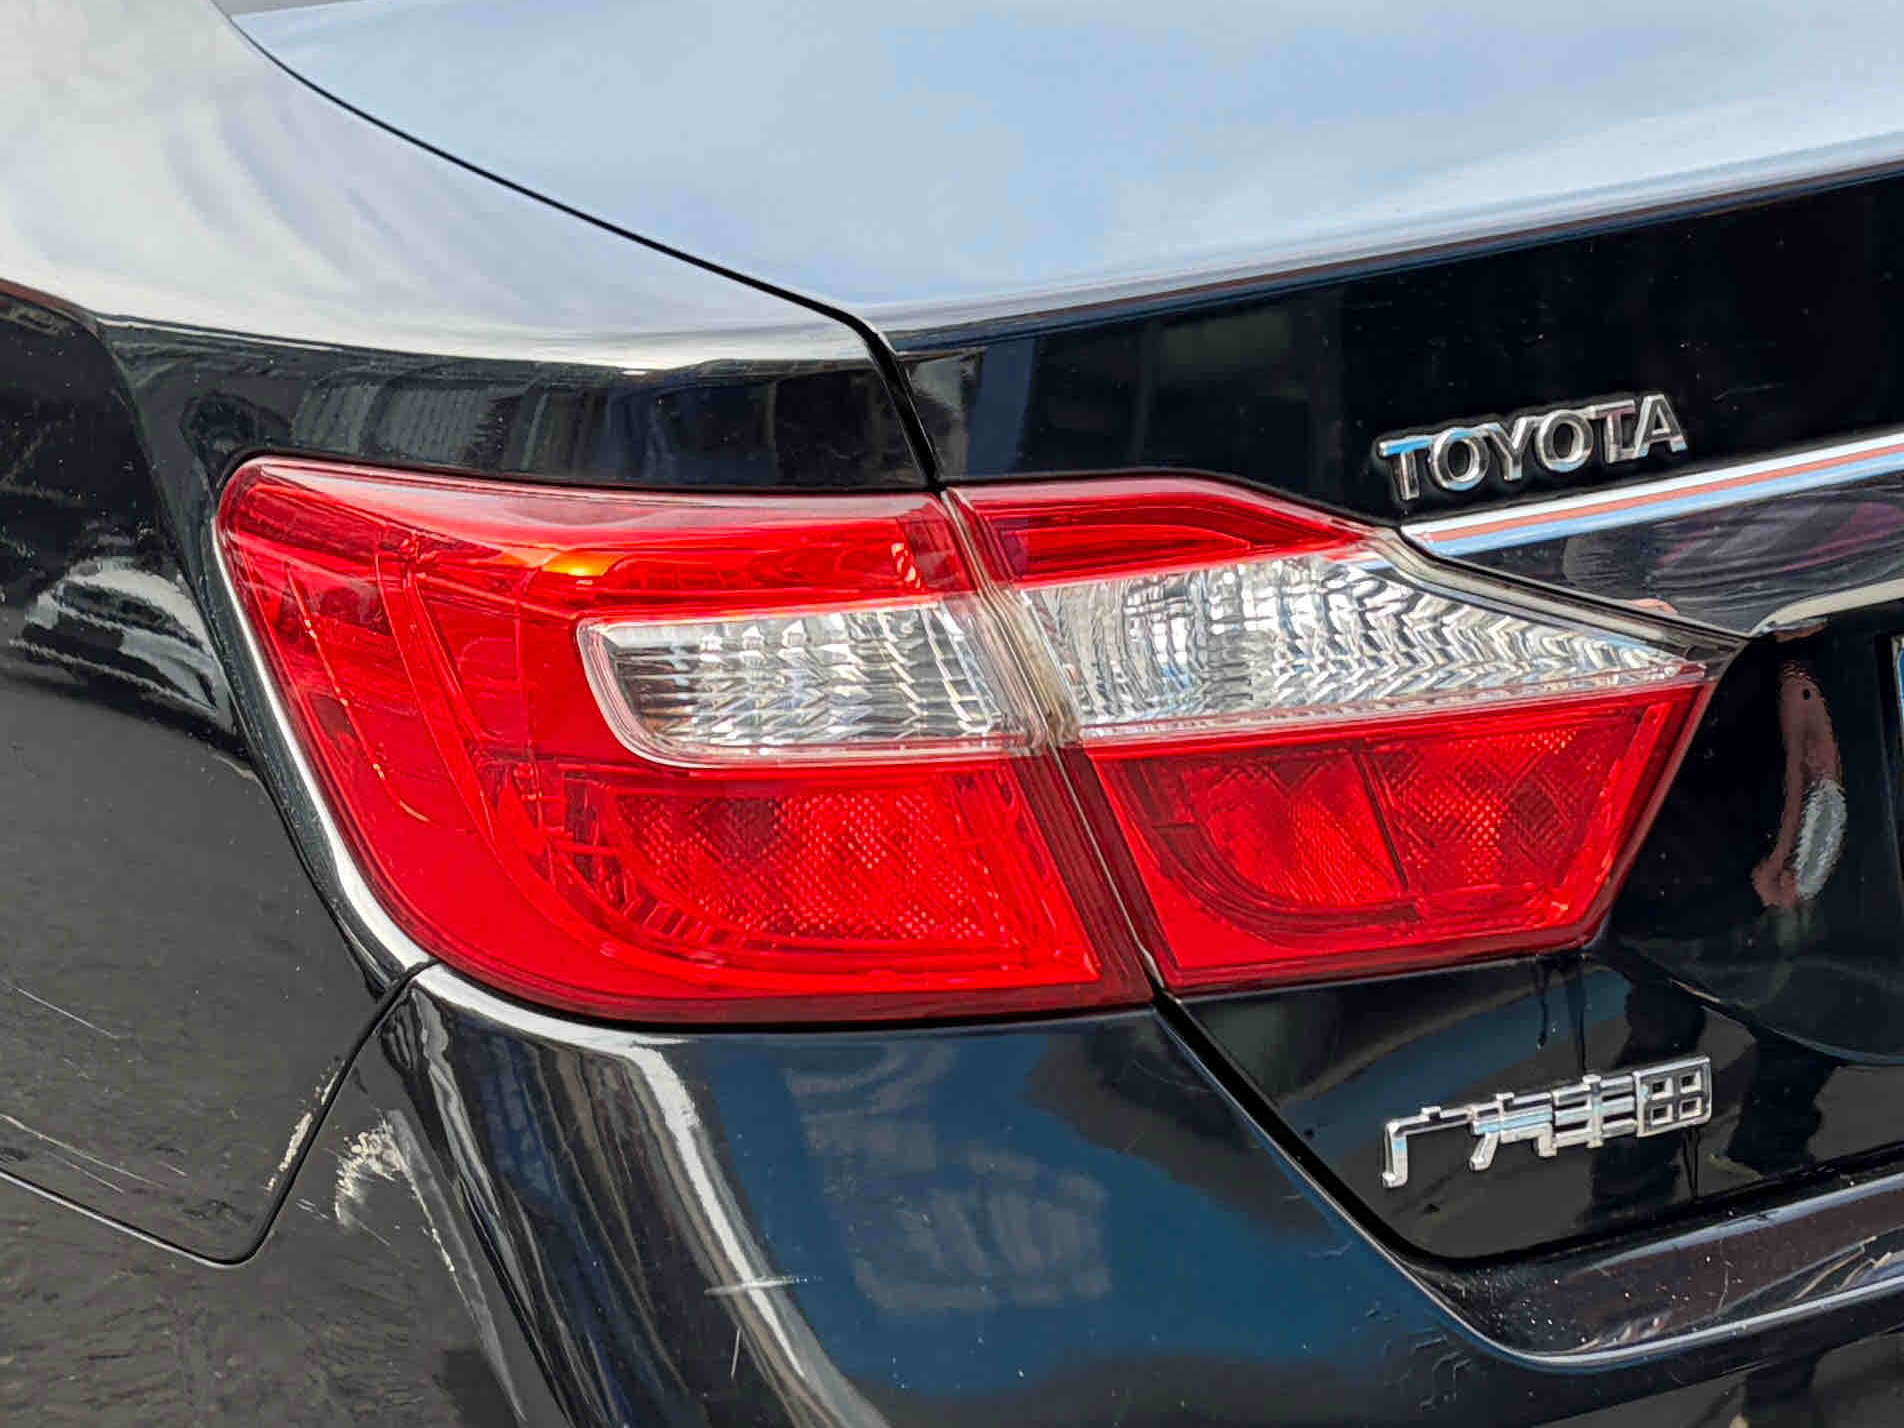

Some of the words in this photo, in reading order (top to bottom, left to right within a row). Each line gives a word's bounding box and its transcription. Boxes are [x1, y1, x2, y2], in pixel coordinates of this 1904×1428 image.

[1379, 393, 1688, 501] TOYOTA
[1381, 1054, 1712, 1189] 广汽丰田
